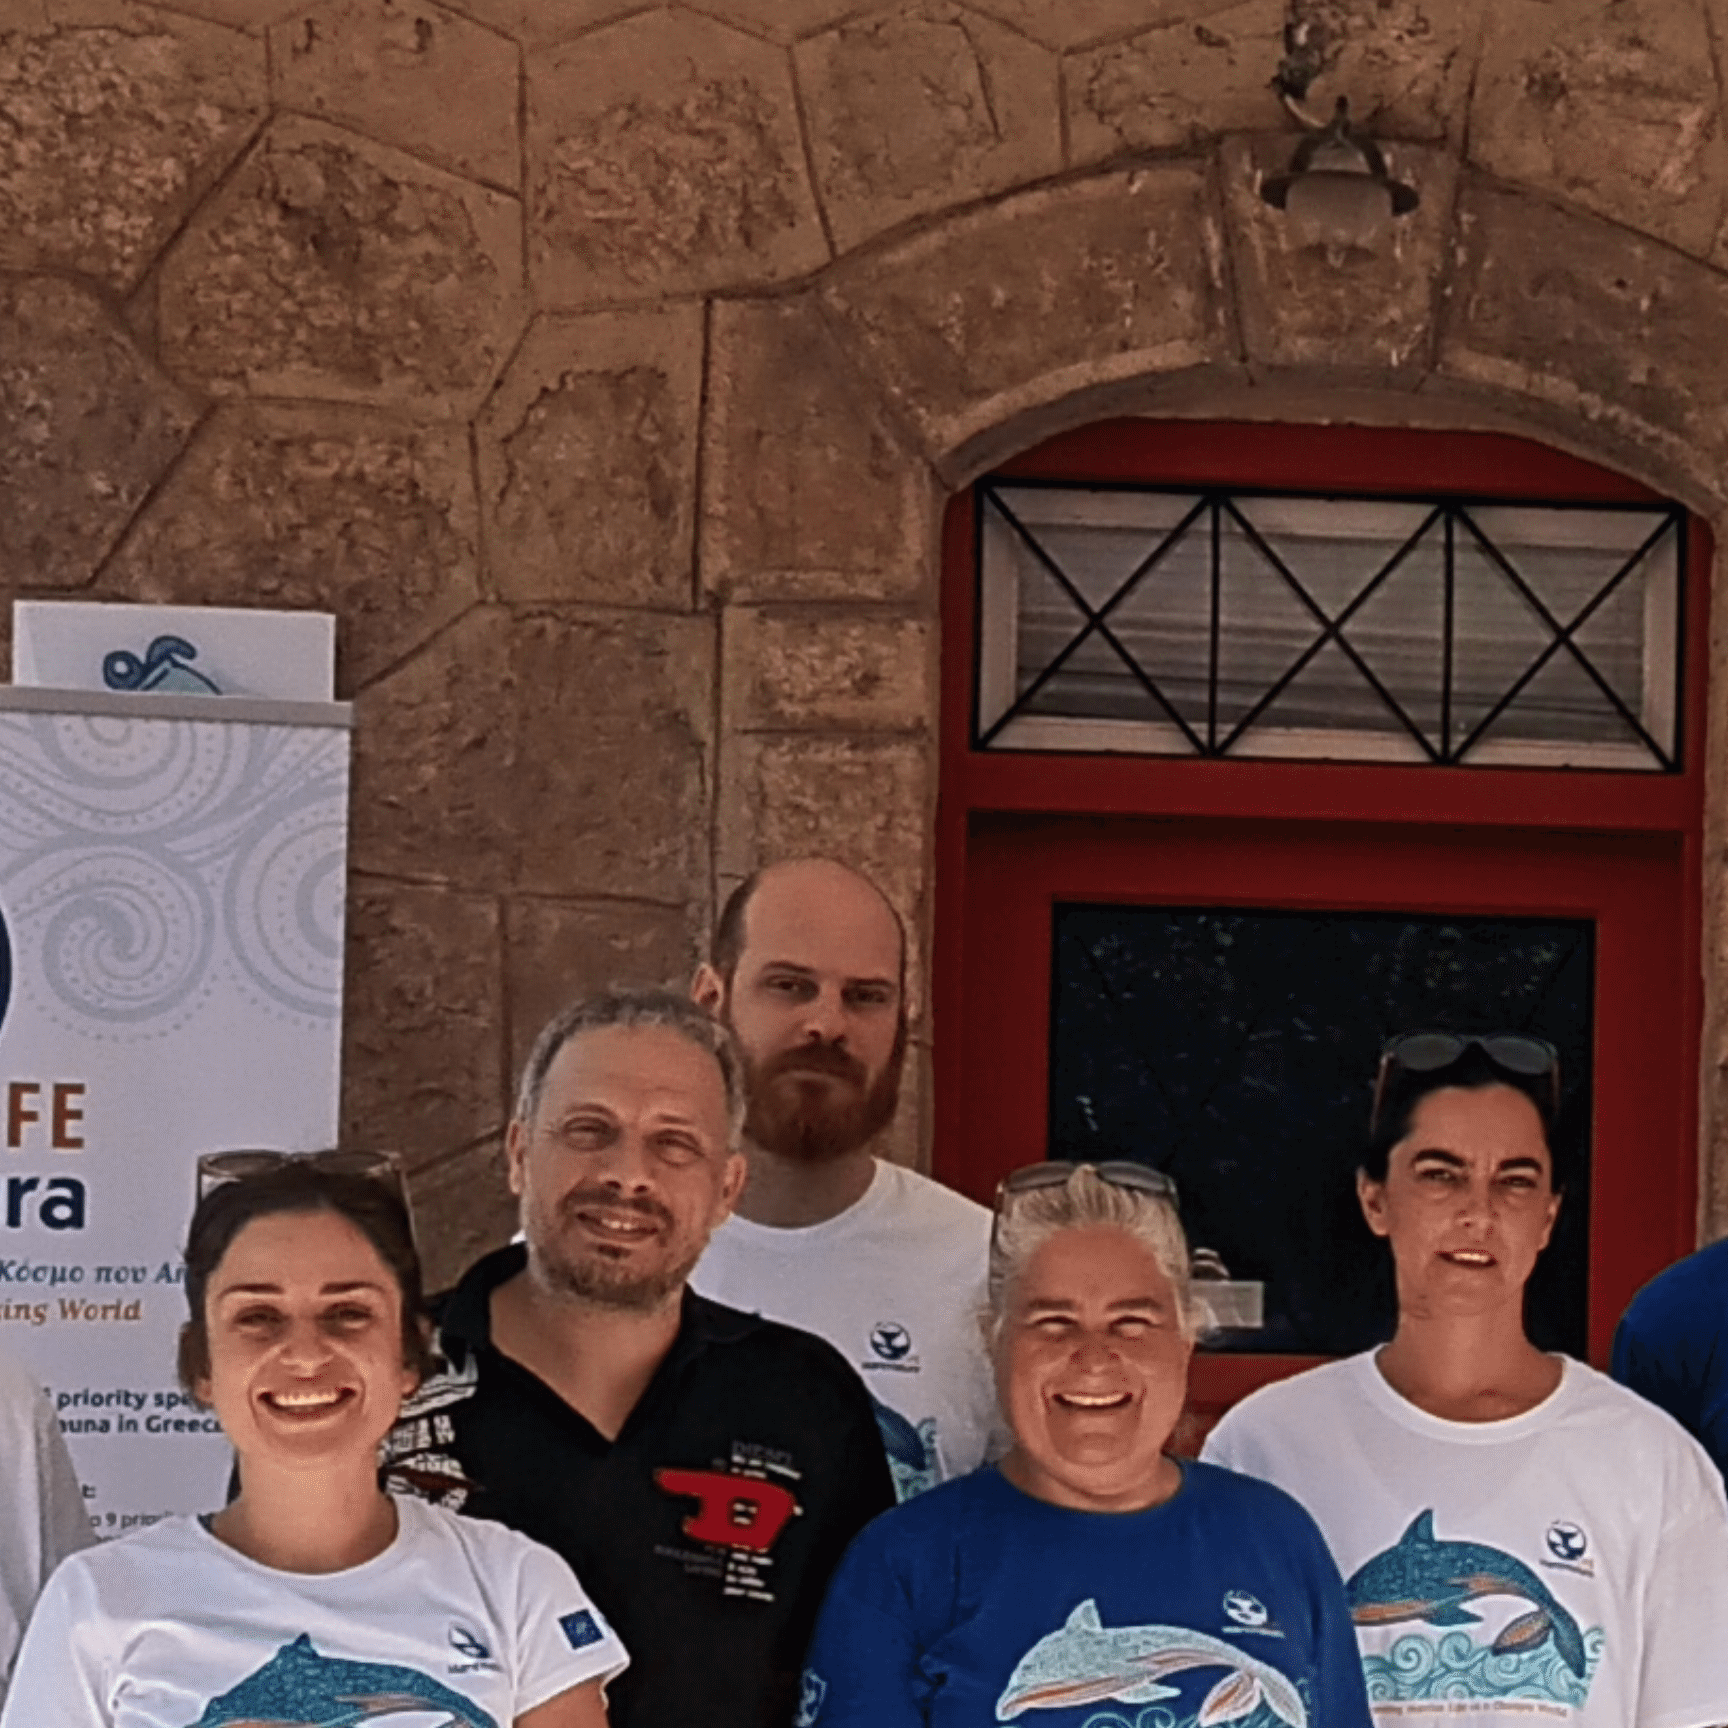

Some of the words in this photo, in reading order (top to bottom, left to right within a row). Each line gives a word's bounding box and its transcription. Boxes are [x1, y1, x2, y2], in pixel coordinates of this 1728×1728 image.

[94, 1265, 146, 1284] που
[58, 1298, 142, 1321] World
[58, 1387, 148, 1411] priority
[118, 1413, 139, 1433] in
